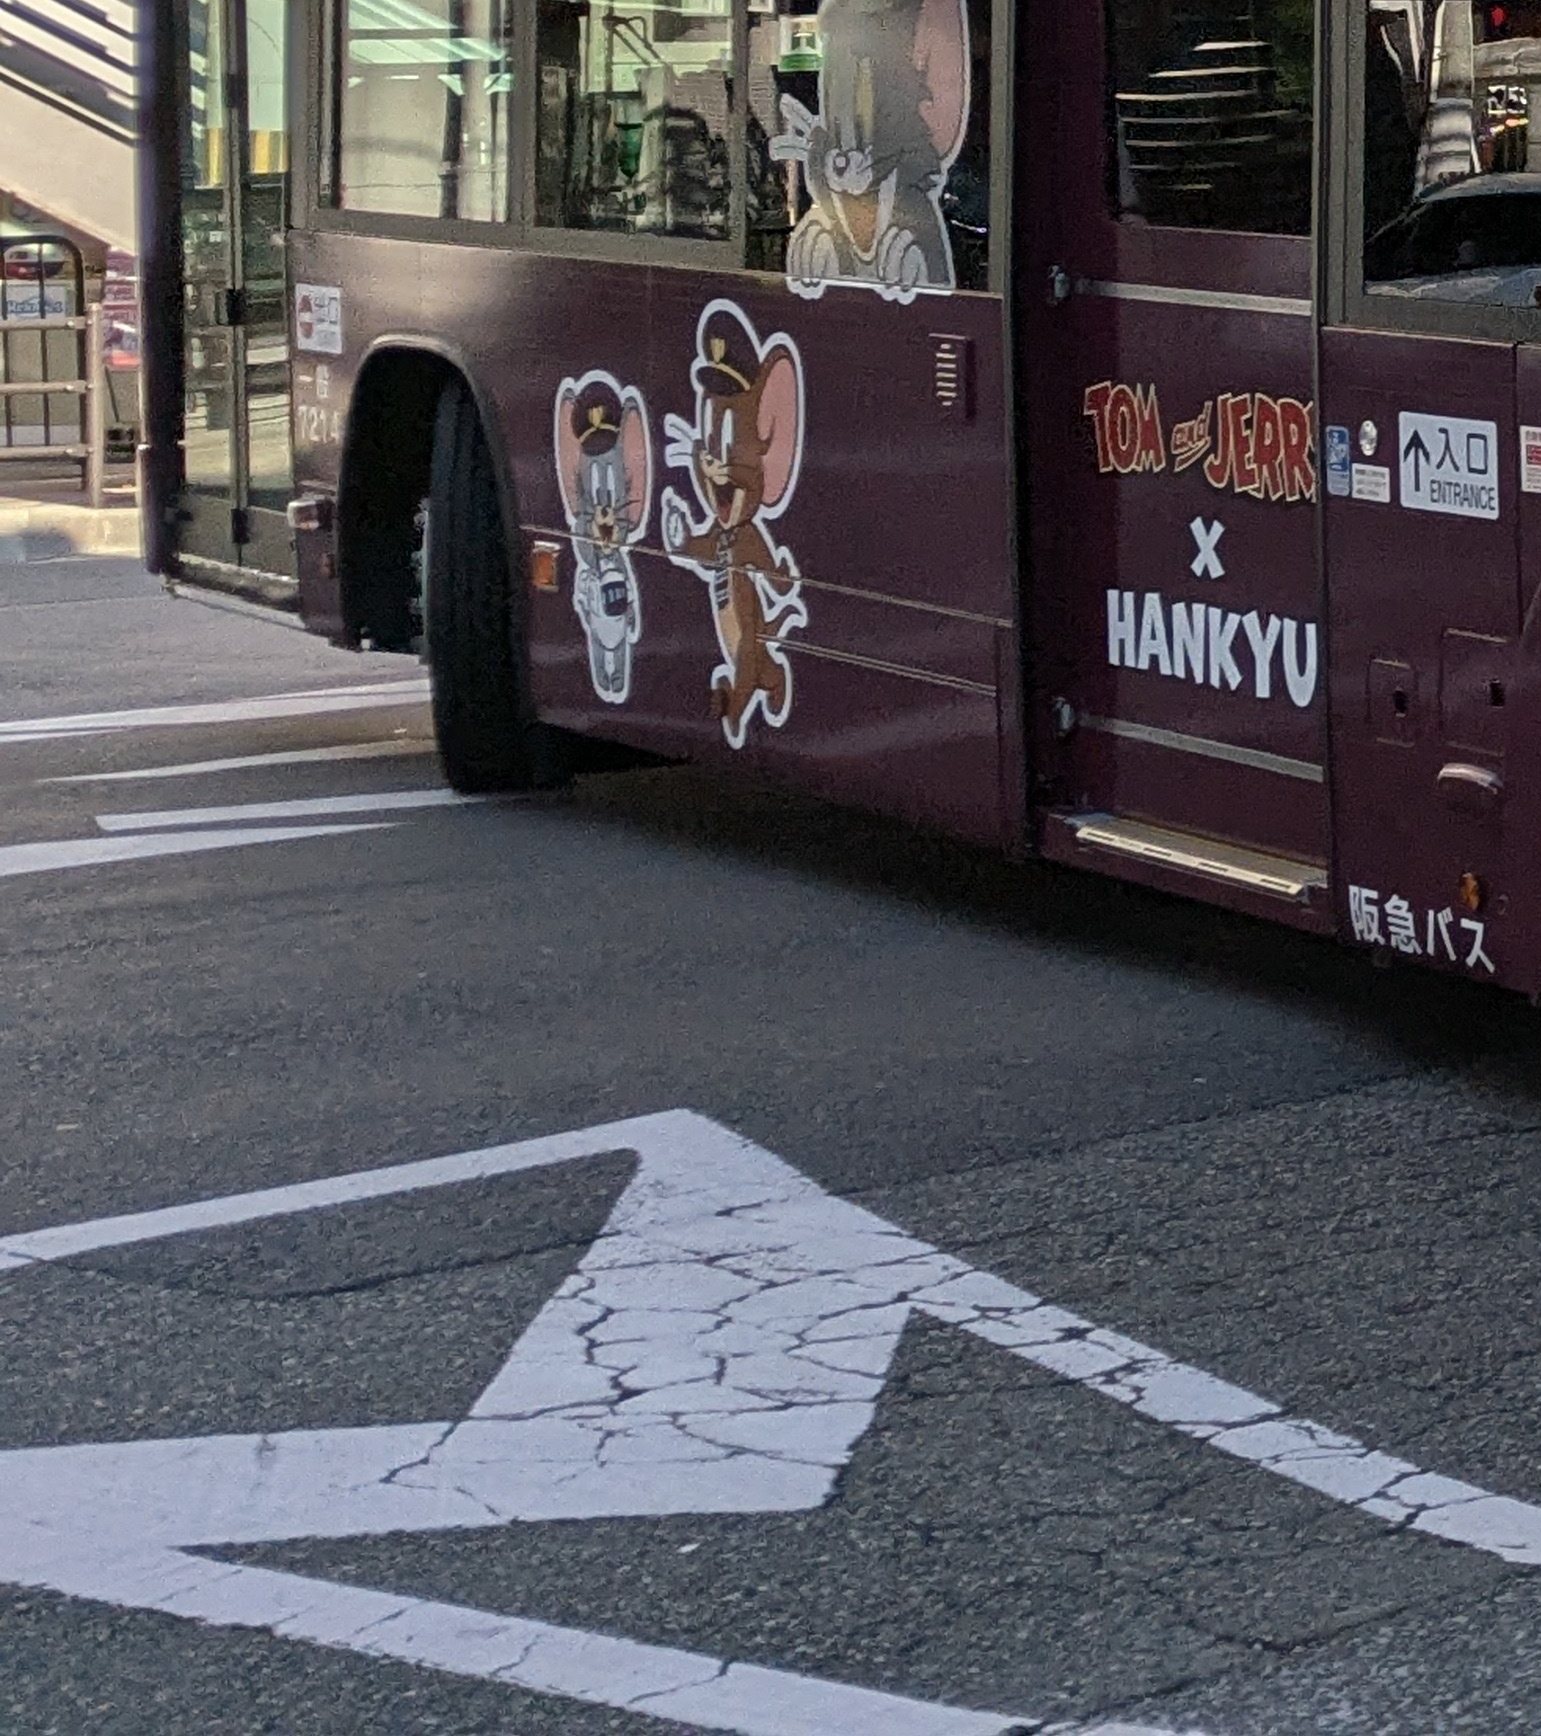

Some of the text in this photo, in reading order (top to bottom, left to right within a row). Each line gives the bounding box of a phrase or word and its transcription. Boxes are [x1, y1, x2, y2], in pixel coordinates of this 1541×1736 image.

[1084, 380, 1166, 474] TOM
[1436, 427, 1487, 476] 入口
[1430, 479, 1496, 512] ENTRANCE
[1106, 588, 1318, 707] HANKYU
[1348, 884, 1496, 975] 阪急バス
